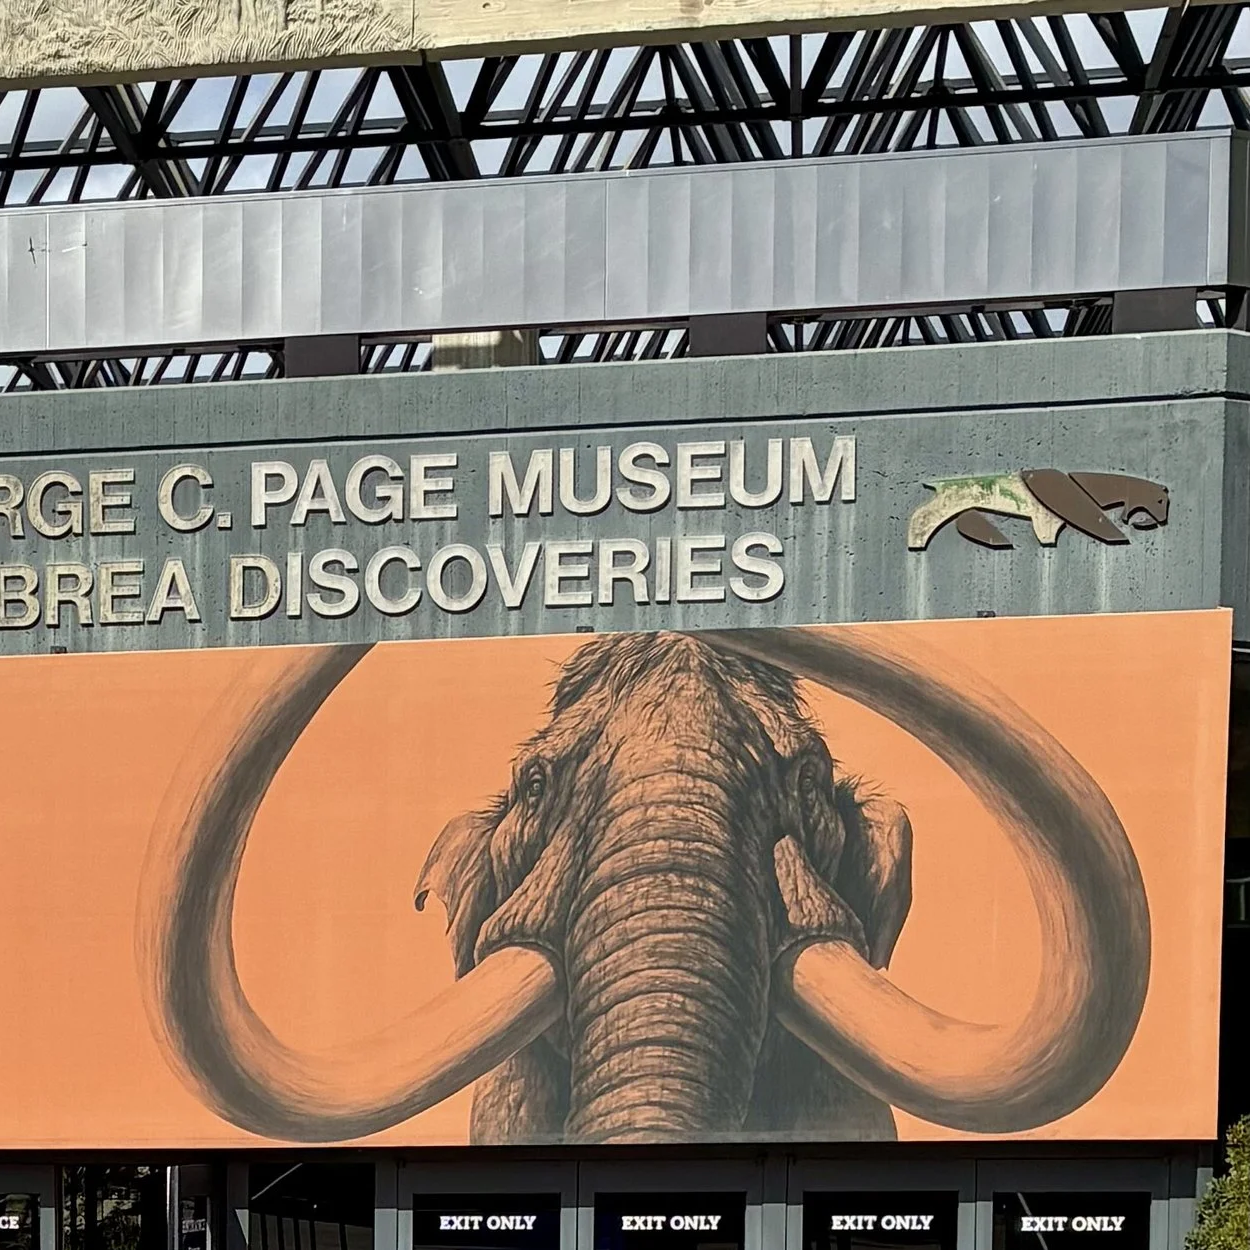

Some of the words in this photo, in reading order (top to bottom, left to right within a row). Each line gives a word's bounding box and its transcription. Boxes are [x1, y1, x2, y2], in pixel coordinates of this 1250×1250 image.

[157, 463, 233, 532] C.
[250, 452, 458, 527] PAGE
[488, 434, 857, 518] MUSEUM
[229, 531, 786, 622] DISCOVERIES
[439, 1215, 483, 1231] EXIT
[486, 1215, 537, 1231] ONLY
[621, 1215, 666, 1231] EXIT
[669, 1215, 722, 1231] ONLY
[831, 1215, 877, 1231] EXIT
[880, 1215, 934, 1231] ONLY
[1020, 1216, 1068, 1232] EXIT
[1071, 1216, 1125, 1232] ONLY
